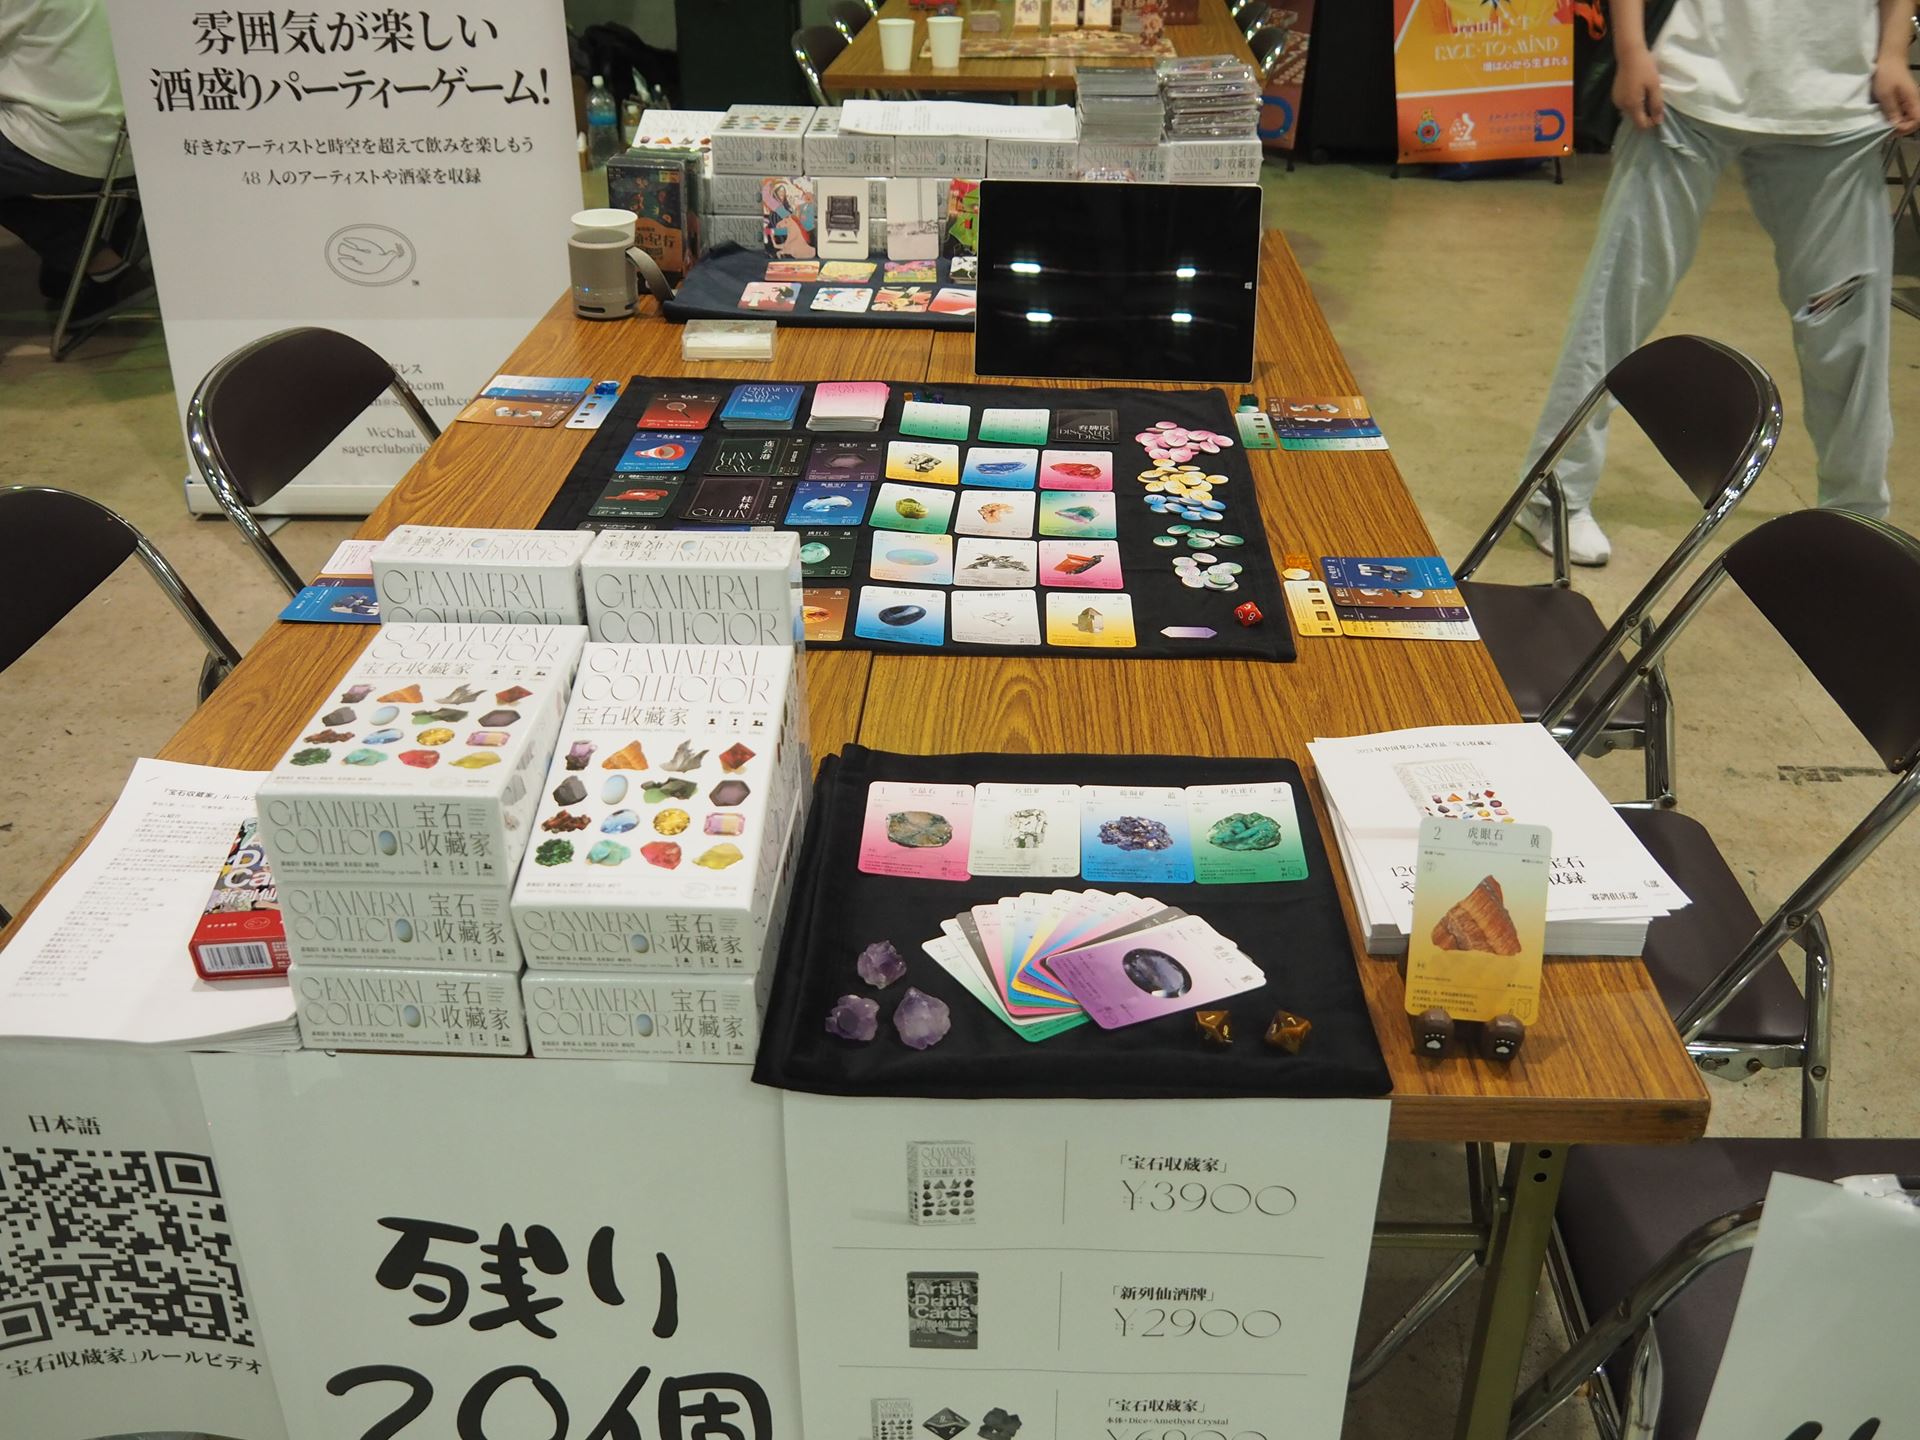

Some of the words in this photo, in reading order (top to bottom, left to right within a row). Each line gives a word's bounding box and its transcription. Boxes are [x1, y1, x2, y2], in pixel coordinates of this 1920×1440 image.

[192, 10, 499, 55] 雰囲気が楽しい
[151, 67, 550, 112] 酒盛りパーティーゲーム!
[184, 138, 534, 156] 好きなアーティストと時空を超えて飲みを楽しもう
[267, 168, 482, 186] 人のアーティストや酒豪を収録
[367, 427, 417, 439] WeChat
[413, 803, 464, 828] 宝石
[1433, 826, 1441, 840] 2
[1468, 827, 1504, 841] 虎眼石
[428, 892, 475, 917] 宝石
[665, 912, 713, 933] 宝石
[436, 981, 482, 1004] 宝石
[672, 989, 716, 1013] 宝石
[28, 1114, 102, 1135] 日本語
[1120, 1154, 1227, 1173] 「宝石収蔵家」
[1122, 1179, 1297, 1216] ¥3900
[375, 1217, 679, 1339] 残り
[915, 1281, 970, 1295] Artist
[915, 1295, 970, 1306] Drink
[1113, 1285, 1214, 1302] 「新列仙酒牌」
[915, 1307, 971, 1319] Cards
[1115, 1307, 1282, 1339] ¥2900
[1108, 1398, 1205, 1413] 「宝石収蔵家」
